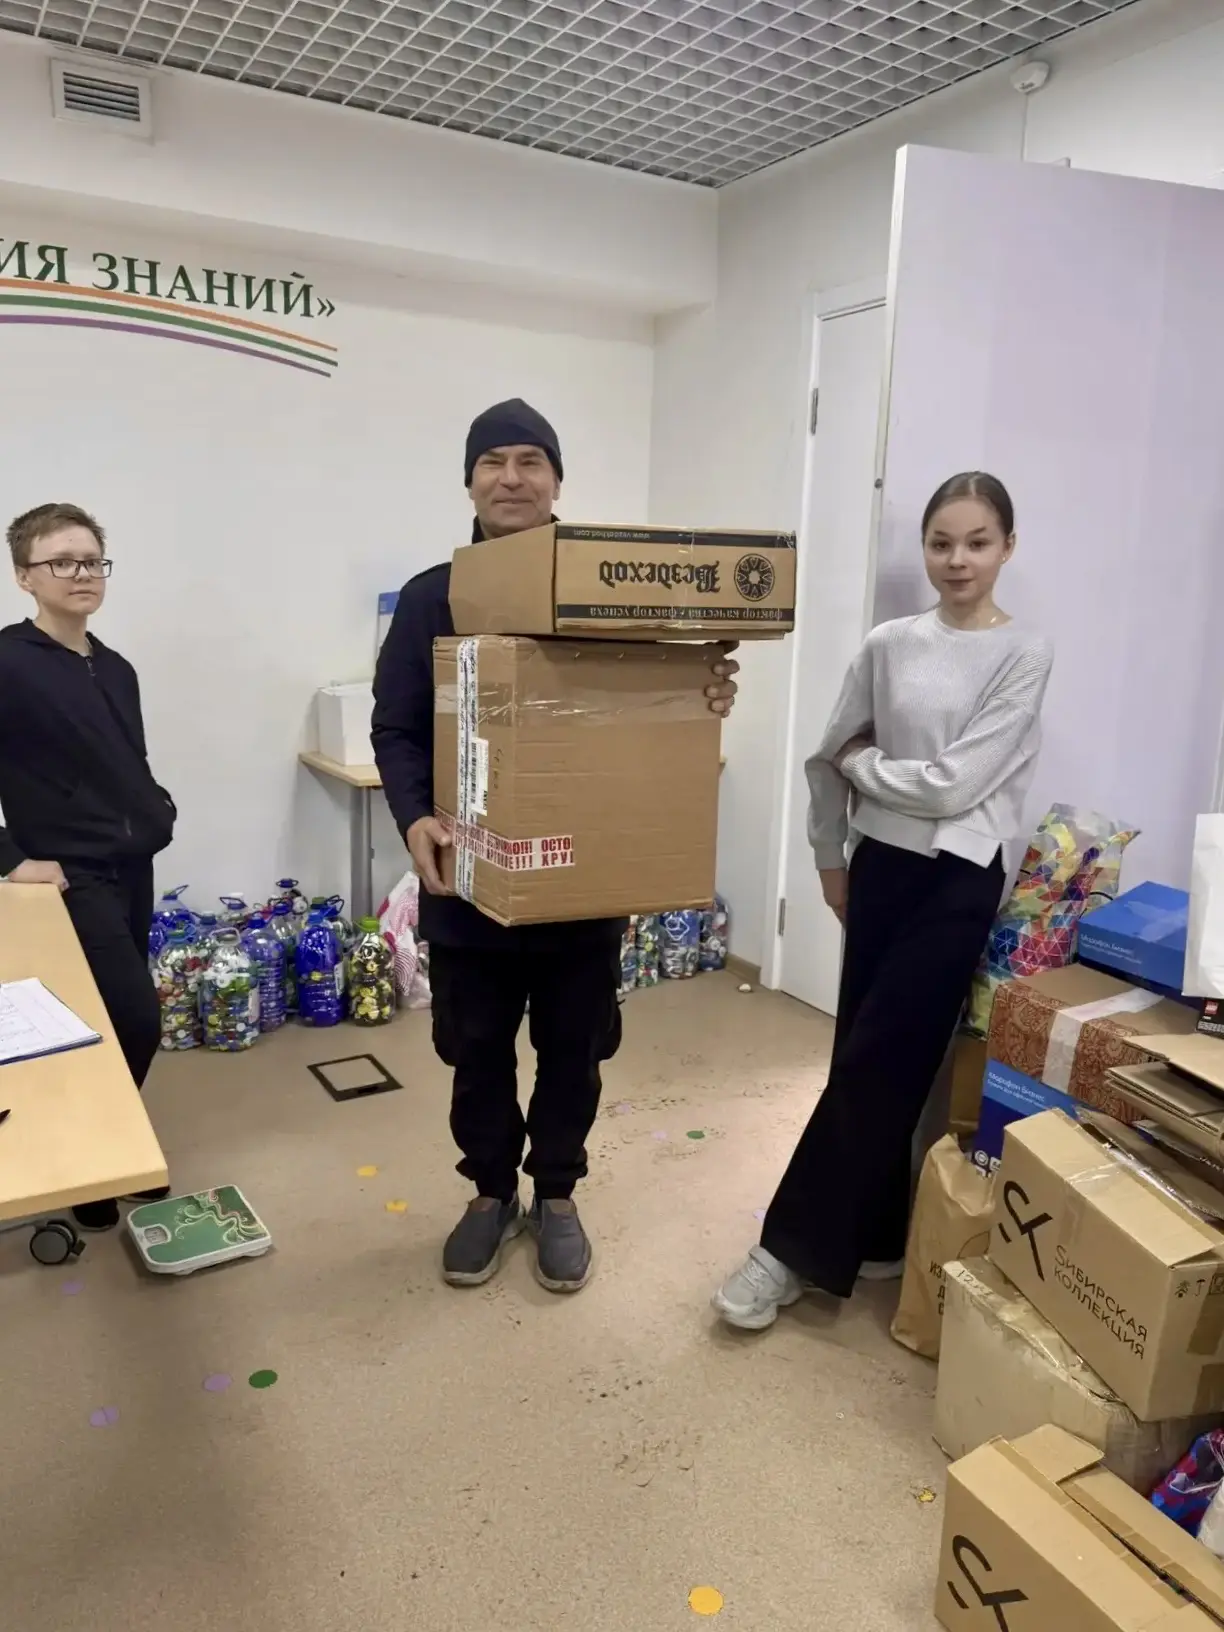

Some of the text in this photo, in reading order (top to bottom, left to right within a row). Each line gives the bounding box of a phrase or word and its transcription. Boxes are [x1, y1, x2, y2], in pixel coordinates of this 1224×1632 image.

[92, 252, 336, 318] ЗНАНИЙ»
[599, 559, 722, 594] Вездеход
[589, 604, 784, 622] фактор качества фактор успеха
[541, 836, 573, 853] ОСТО
[1054, 1264, 1145, 1360] КОЛЛЕКЦИЯ
